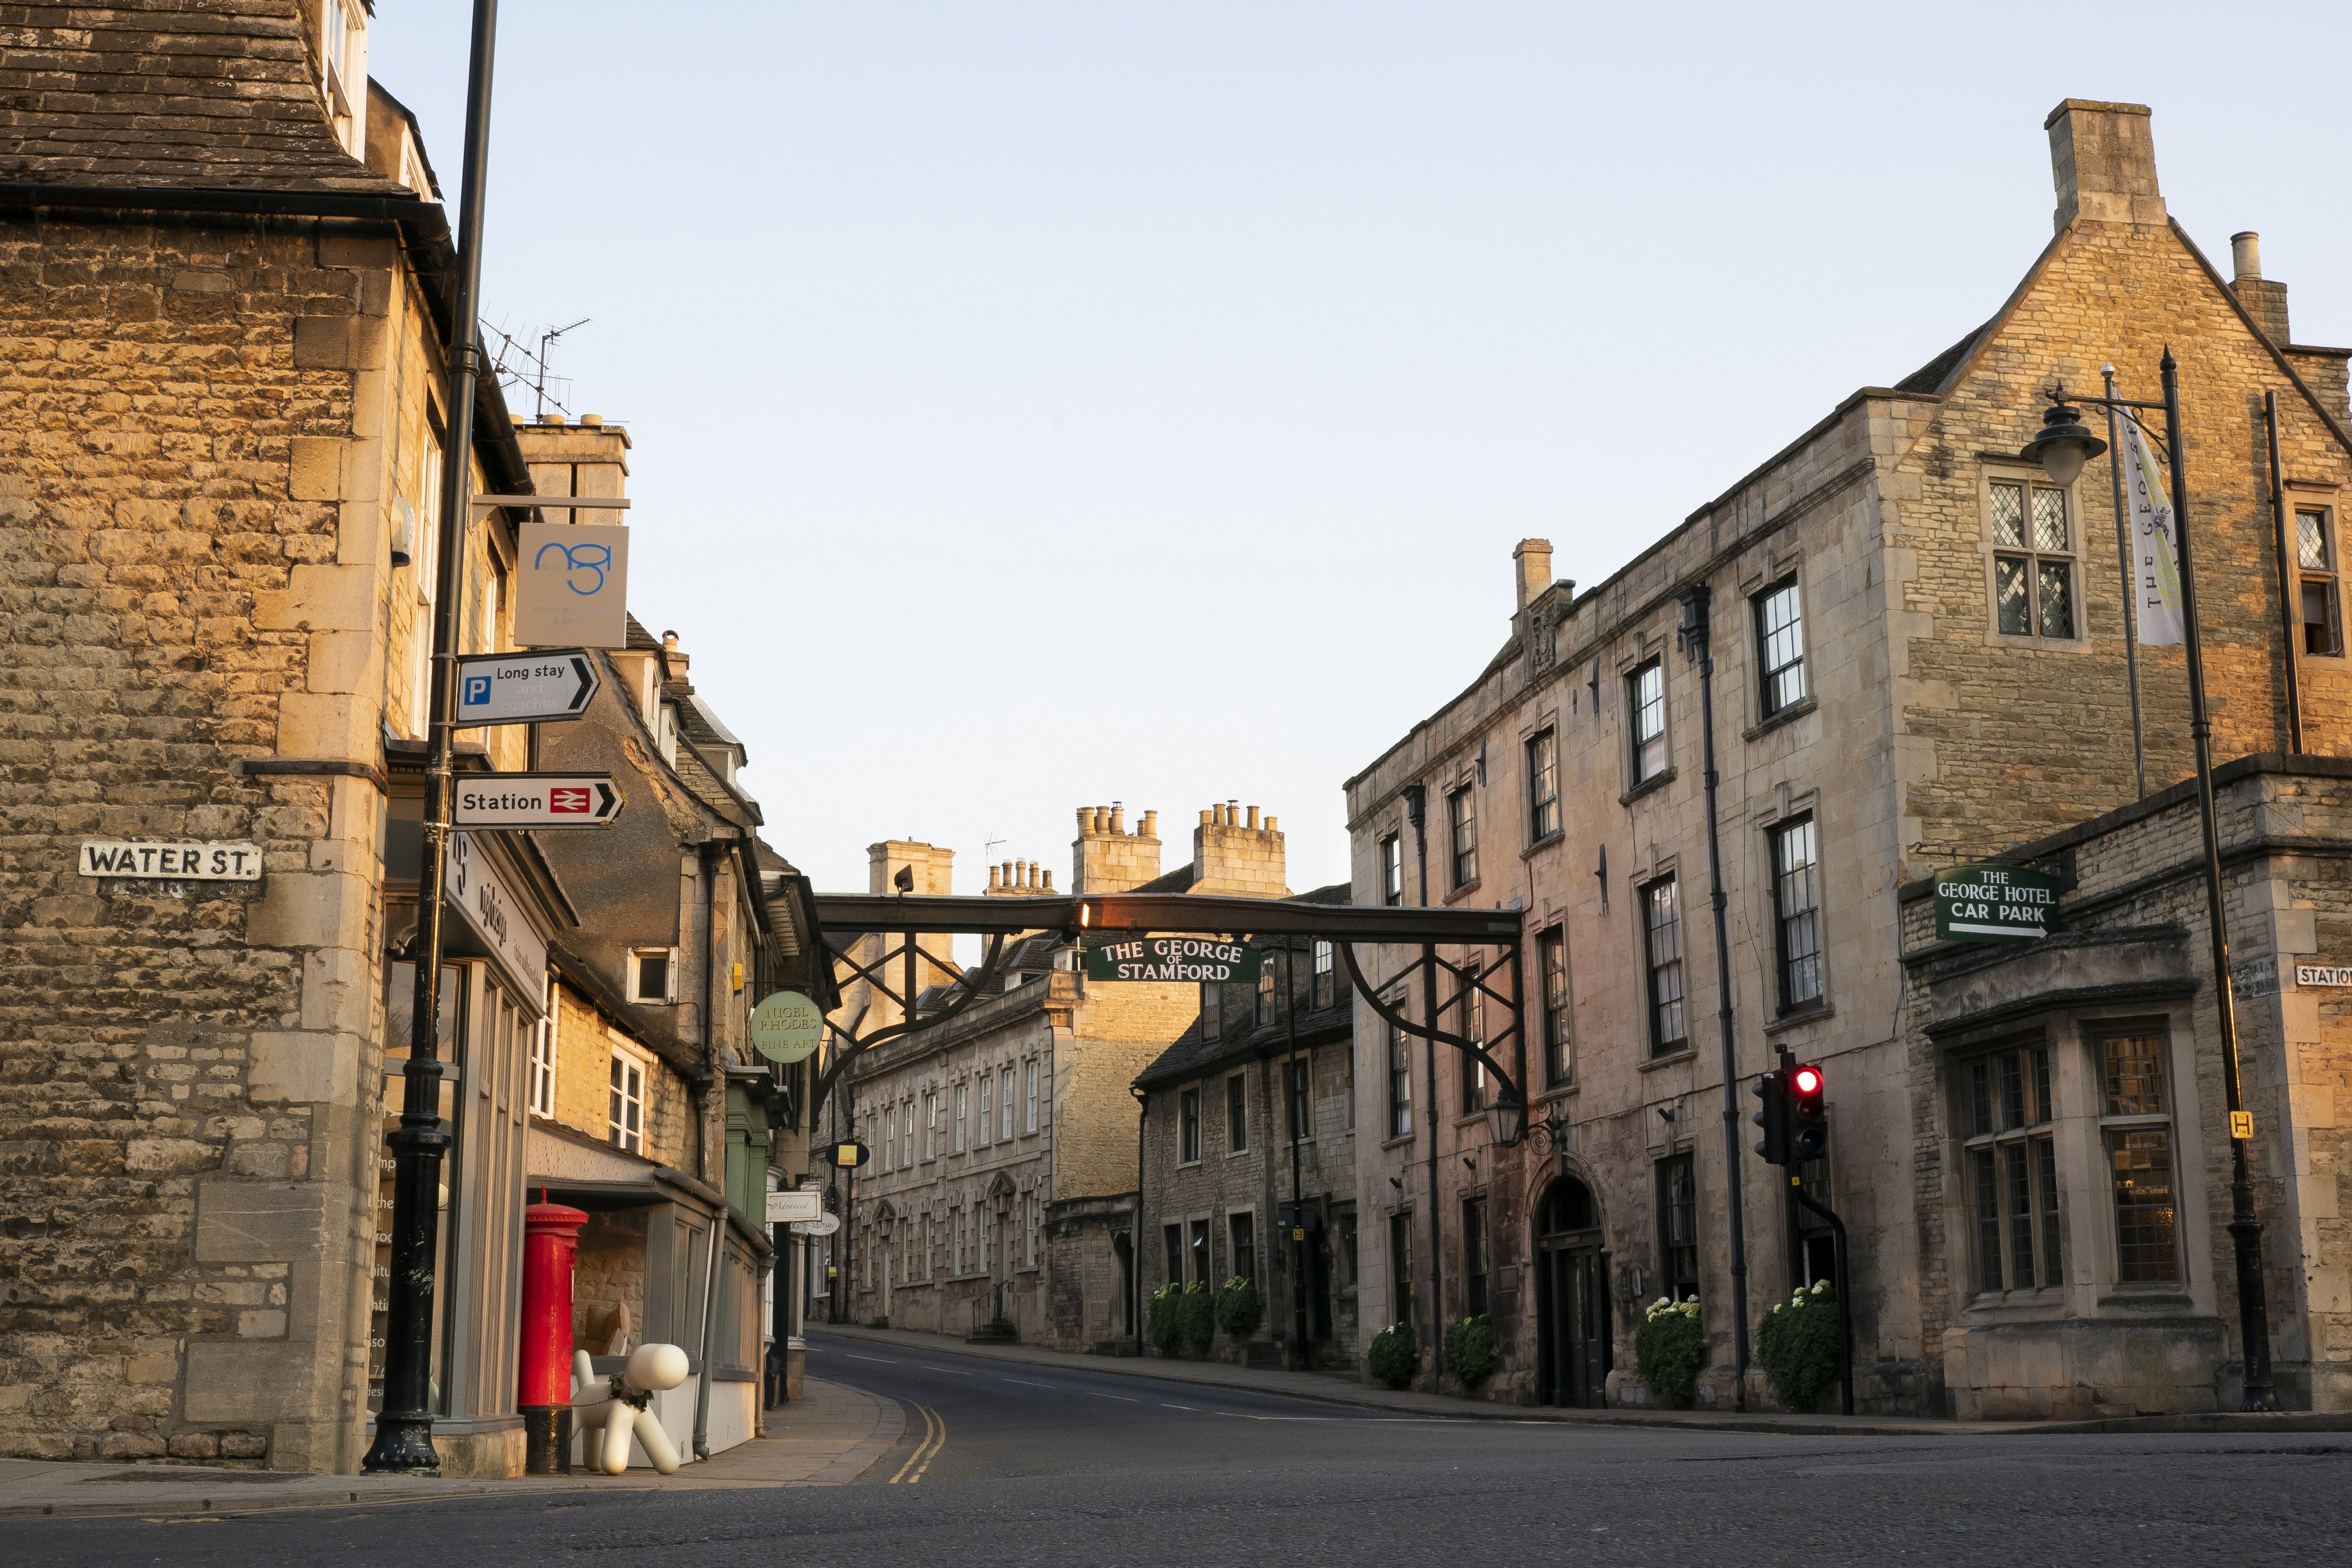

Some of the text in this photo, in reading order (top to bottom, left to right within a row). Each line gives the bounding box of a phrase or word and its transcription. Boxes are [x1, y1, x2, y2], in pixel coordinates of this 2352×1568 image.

[497, 665, 565, 680] Long stay
[470, 680, 486, 702] P
[463, 793, 541, 810] Station
[89, 847, 252, 875] WATER ST.
[1981, 871, 2009, 884] THE
[1938, 882, 2055, 904] GEORGE HOTEL
[1952, 902, 2045, 922] CAR PARK
[1101, 940, 1242, 963] THE GEORGE
[1167, 955, 1182, 964] OF
[1118, 964, 1230, 980] STAMFORD
[766, 1007, 808, 1018] NIGEL
[760, 1019, 816, 1031] RHODES
[761, 1039, 816, 1049] FINE ART
[2234, 1115, 2250, 1135] H
[773, 1197, 813, 1211] Advanced
